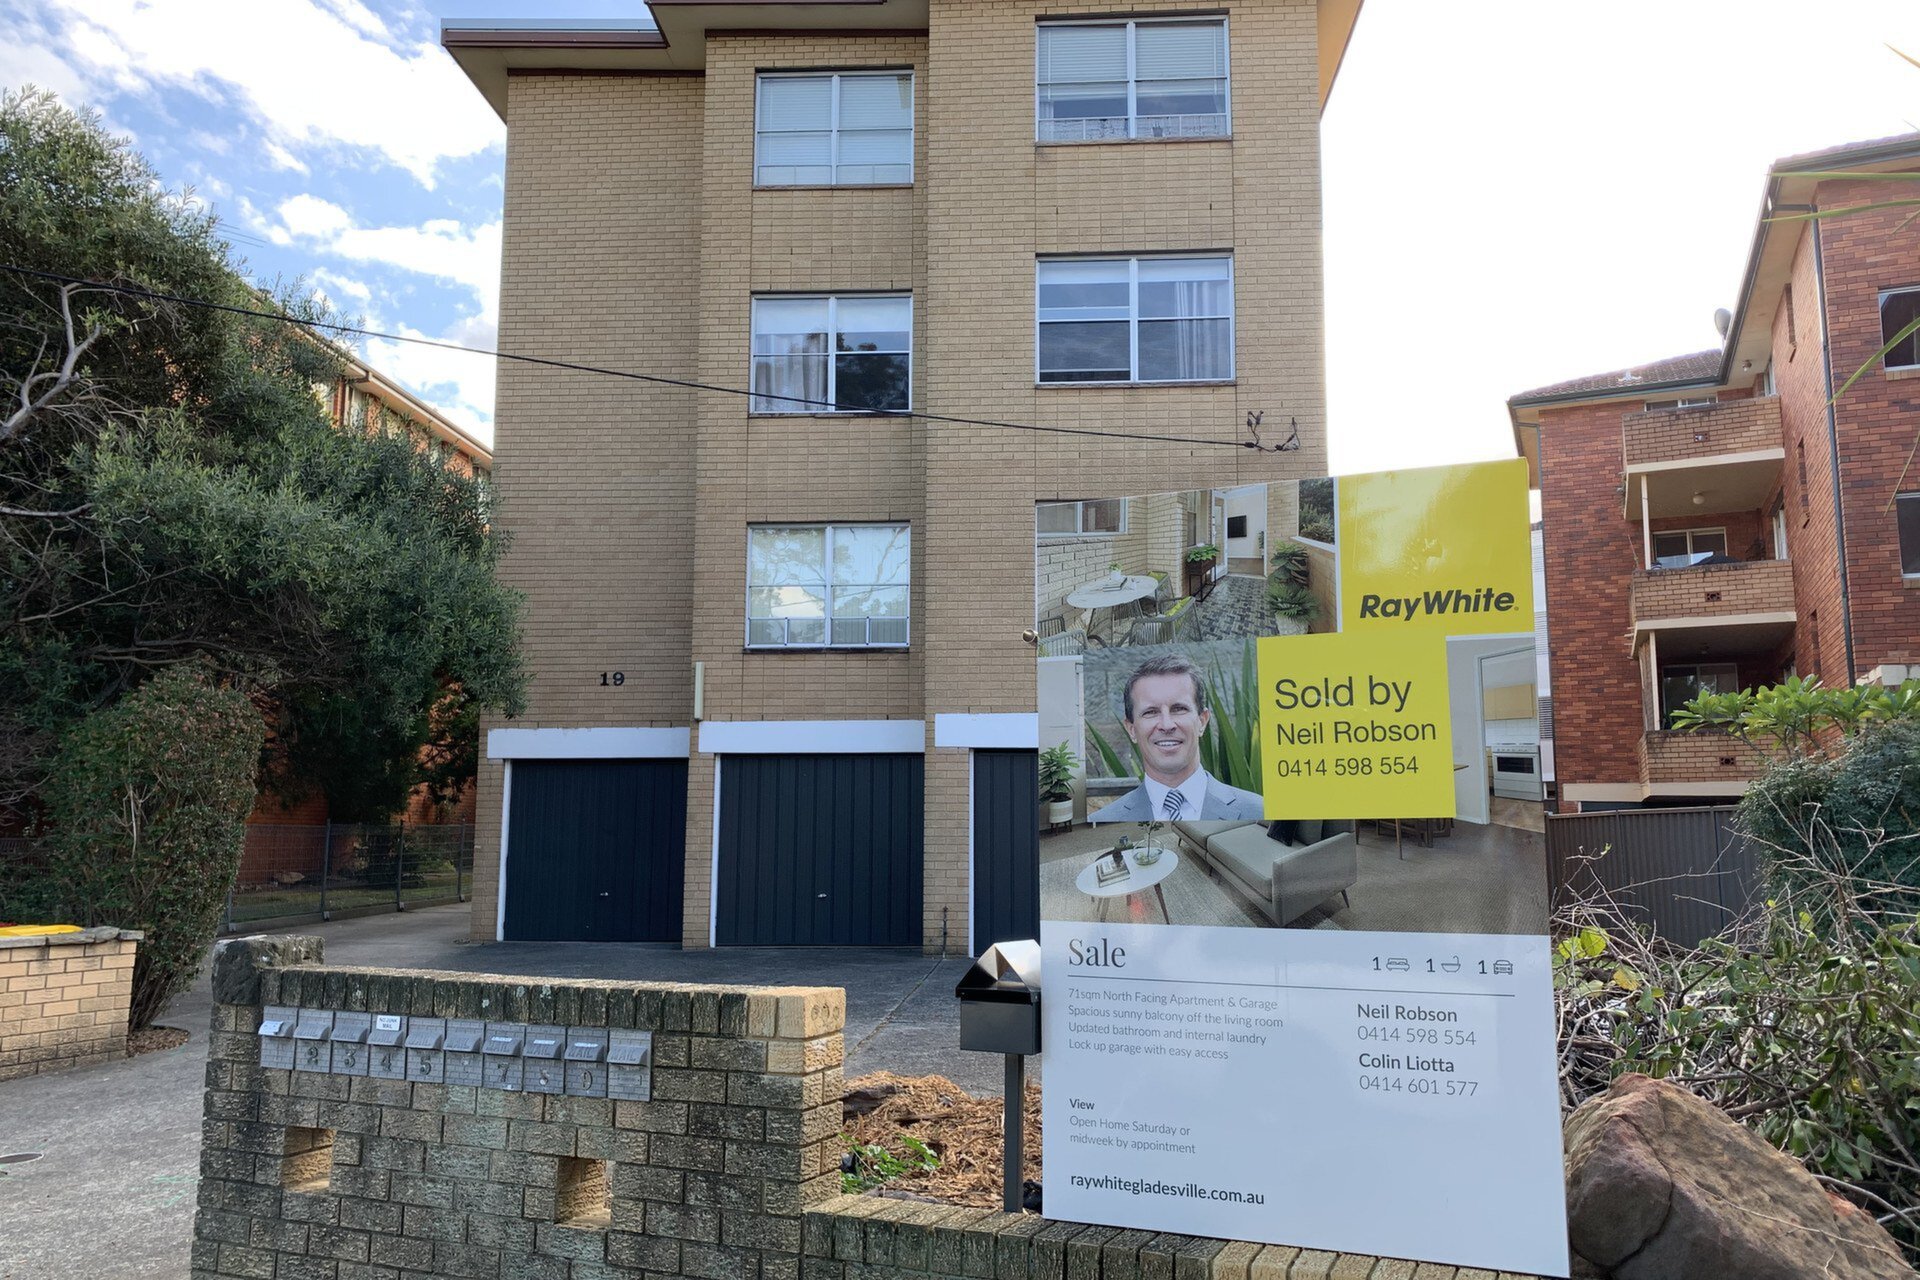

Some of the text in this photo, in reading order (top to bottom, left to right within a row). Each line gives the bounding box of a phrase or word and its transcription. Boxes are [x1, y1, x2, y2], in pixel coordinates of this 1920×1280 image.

[1360, 587, 1515, 621] RayWhite
[600, 671, 625, 686] 19
[1276, 675, 1412, 712] Sold by
[1277, 720, 1436, 745] Neil Robson
[1278, 756, 1418, 777] 0414 598 554
[1069, 938, 1125, 968] Sale
[1372, 957, 1487, 974] 1 1 1
[1069, 988, 1277, 1011] 71sqm North Facing Apartment & Garage
[1069, 1005, 1283, 1028] Spacious sunny balcony off the living room
[1358, 1004, 1457, 1022] Neil Robson
[1069, 1022, 1266, 1045] Updated bathroom and internal laundry
[1358, 1026, 1476, 1045] 0414 598 554
[307, 1046, 319, 1066] 2
[344, 1048, 356, 1068] 3
[1069, 1039, 1228, 1059] Lock up garage with easy access
[380, 1052, 392, 1073] 4
[420, 1055, 432, 1075] 5
[497, 1063, 510, 1082] 7
[1359, 1053, 1454, 1072] Colin Liotta
[1360, 1075, 1478, 1096] 0414 601 577
[1070, 1099, 1095, 1109] View
[1070, 1116, 1190, 1136] Open Home Saturday or
[1070, 1134, 1195, 1153] midweek by appointment
[1071, 1175, 1264, 1204] raywhitegladesville.com.au
